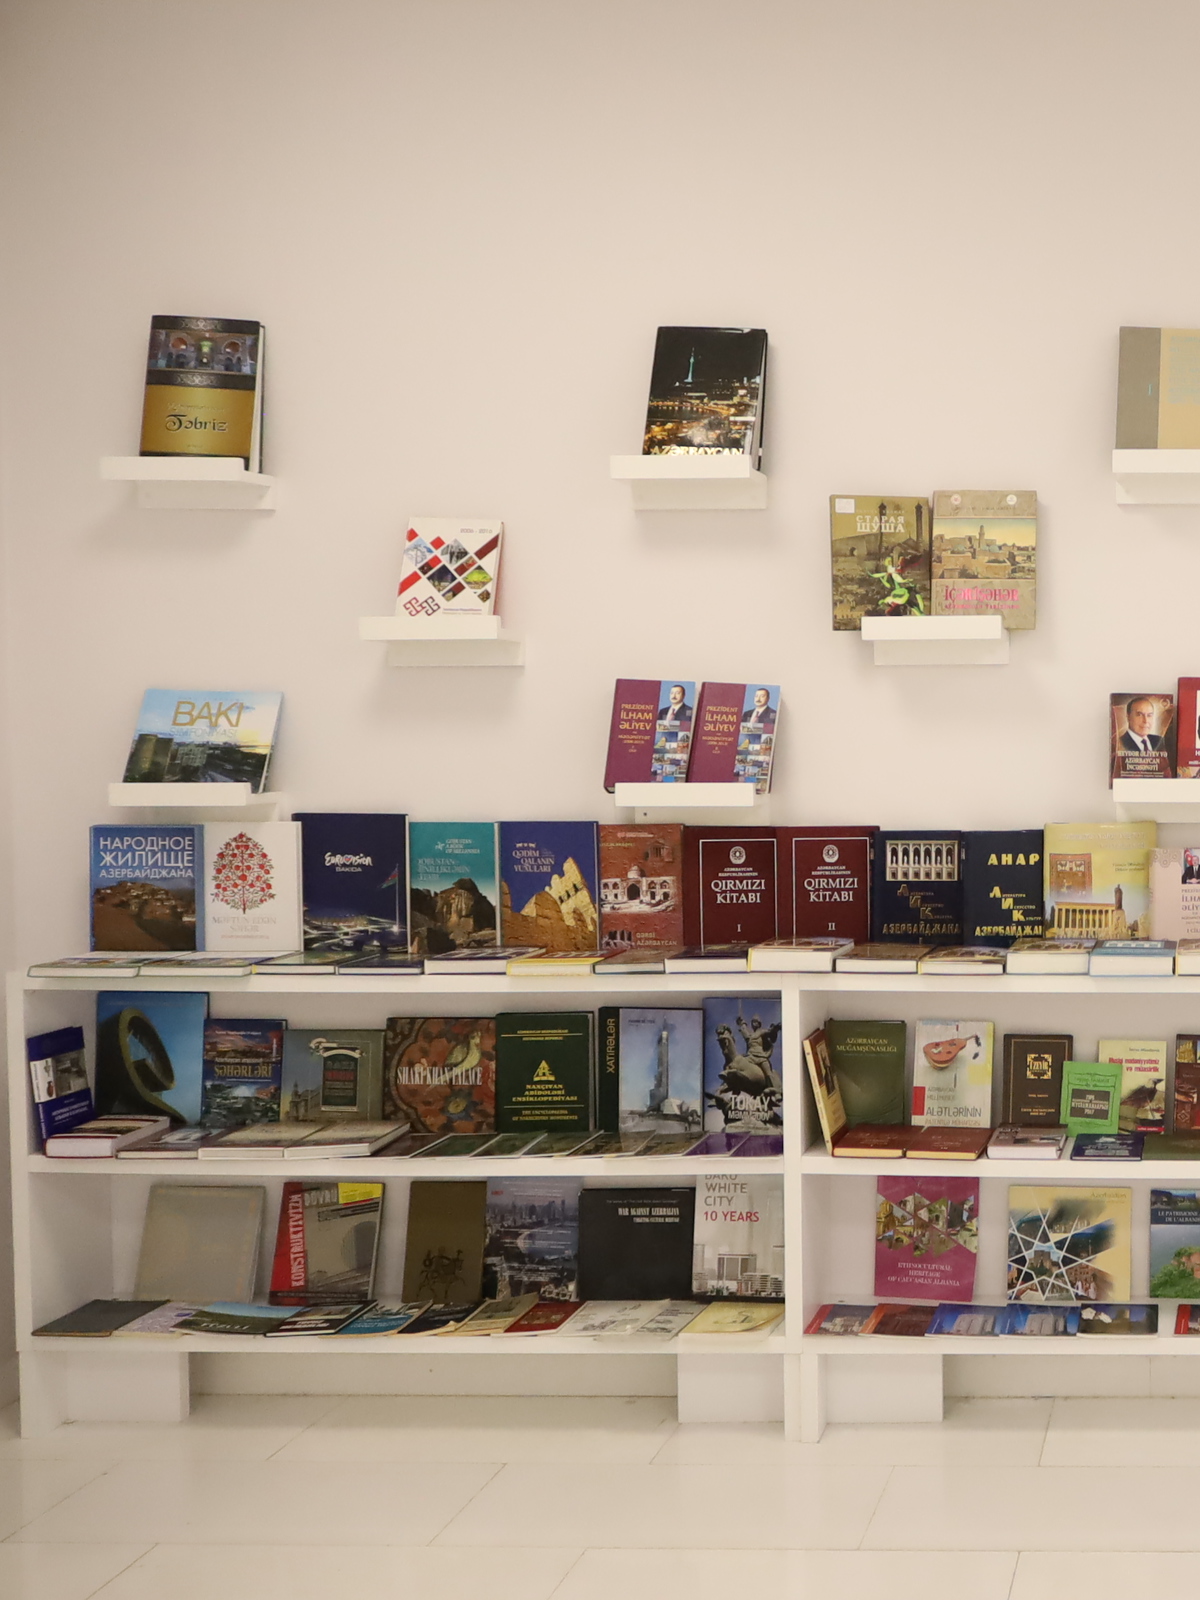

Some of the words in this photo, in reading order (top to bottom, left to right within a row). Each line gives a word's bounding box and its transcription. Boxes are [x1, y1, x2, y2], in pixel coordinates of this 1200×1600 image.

[856, 515, 904, 523] СТАРАЯ
[857, 523, 904, 533] ШУША
[172, 701, 244, 727] BAKI
[621, 710, 652, 720] İLHAM
[706, 712, 736, 722] İLHAM
[619, 721, 651, 730] ƏLİYEV
[704, 723, 736, 732] ƏLİYEV
[100, 837, 193, 850] НАРОДНОЕ
[513, 850, 539, 858] QƏDİM
[988, 853, 1039, 865] АНАР
[100, 851, 193, 869] ЖИЛИЩЕ
[521, 857, 555, 865] QALANIN
[99, 867, 194, 879] АЗЕРБАЙДЖАНА
[711, 879, 765, 892] QIRMIZI
[804, 878, 858, 890] QIRMIZI
[716, 891, 761, 904] KİTABI
[809, 889, 853, 902] KİTABI
[737, 924, 741, 932] I
[397, 1067, 424, 1085] SHAKI
[427, 1067, 450, 1085] KHAN
[452, 1067, 482, 1085] PALACE
[730, 1095, 770, 1111] TOKAY
[926, 1106, 981, 1117] ALƏTLƏRİNİN
[706, 1183, 748, 1194] WHITE
[704, 1196, 735, 1206] CITY
[704, 1211, 718, 1221] 10
[722, 1211, 760, 1222] YEARS
